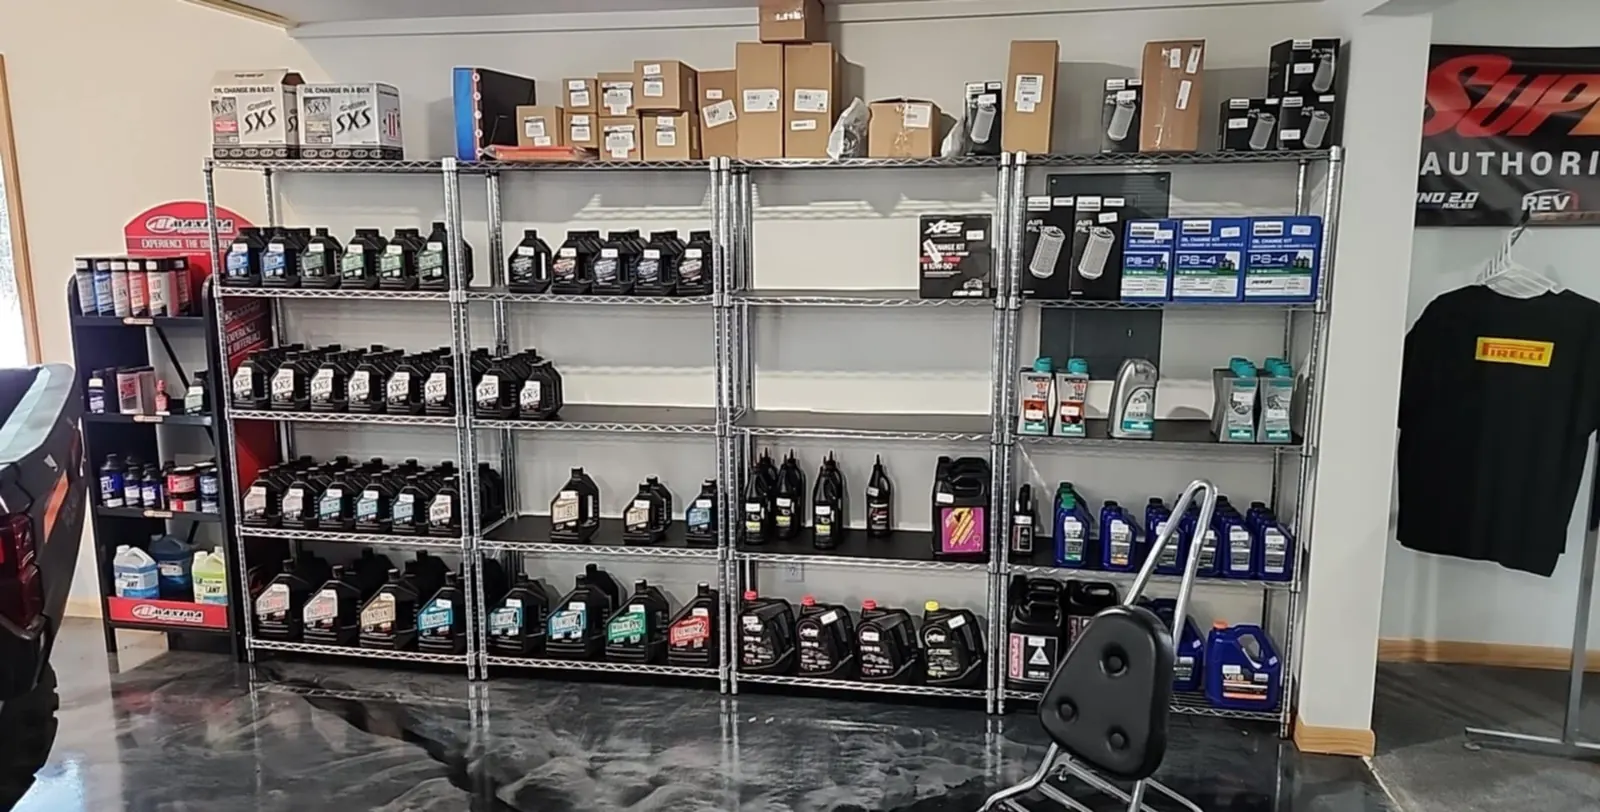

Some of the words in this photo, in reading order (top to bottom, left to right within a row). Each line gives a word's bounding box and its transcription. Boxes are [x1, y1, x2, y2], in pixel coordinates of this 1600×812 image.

[244, 107, 277, 134] SXS
[335, 107, 372, 134] SXS
[1420, 151, 1600, 176] AUTHORI
[1449, 192, 1480, 203] 2.0
[924, 220, 964, 235] XPS
[141, 239, 182, 249] EXPERIENCE
[185, 239, 199, 249] THE
[1126, 257, 1155, 265] PS-4
[1178, 255, 1217, 265] PS-4
[1250, 254, 1289, 264] PS-4
[152, 609, 203, 618] MAXIMA
